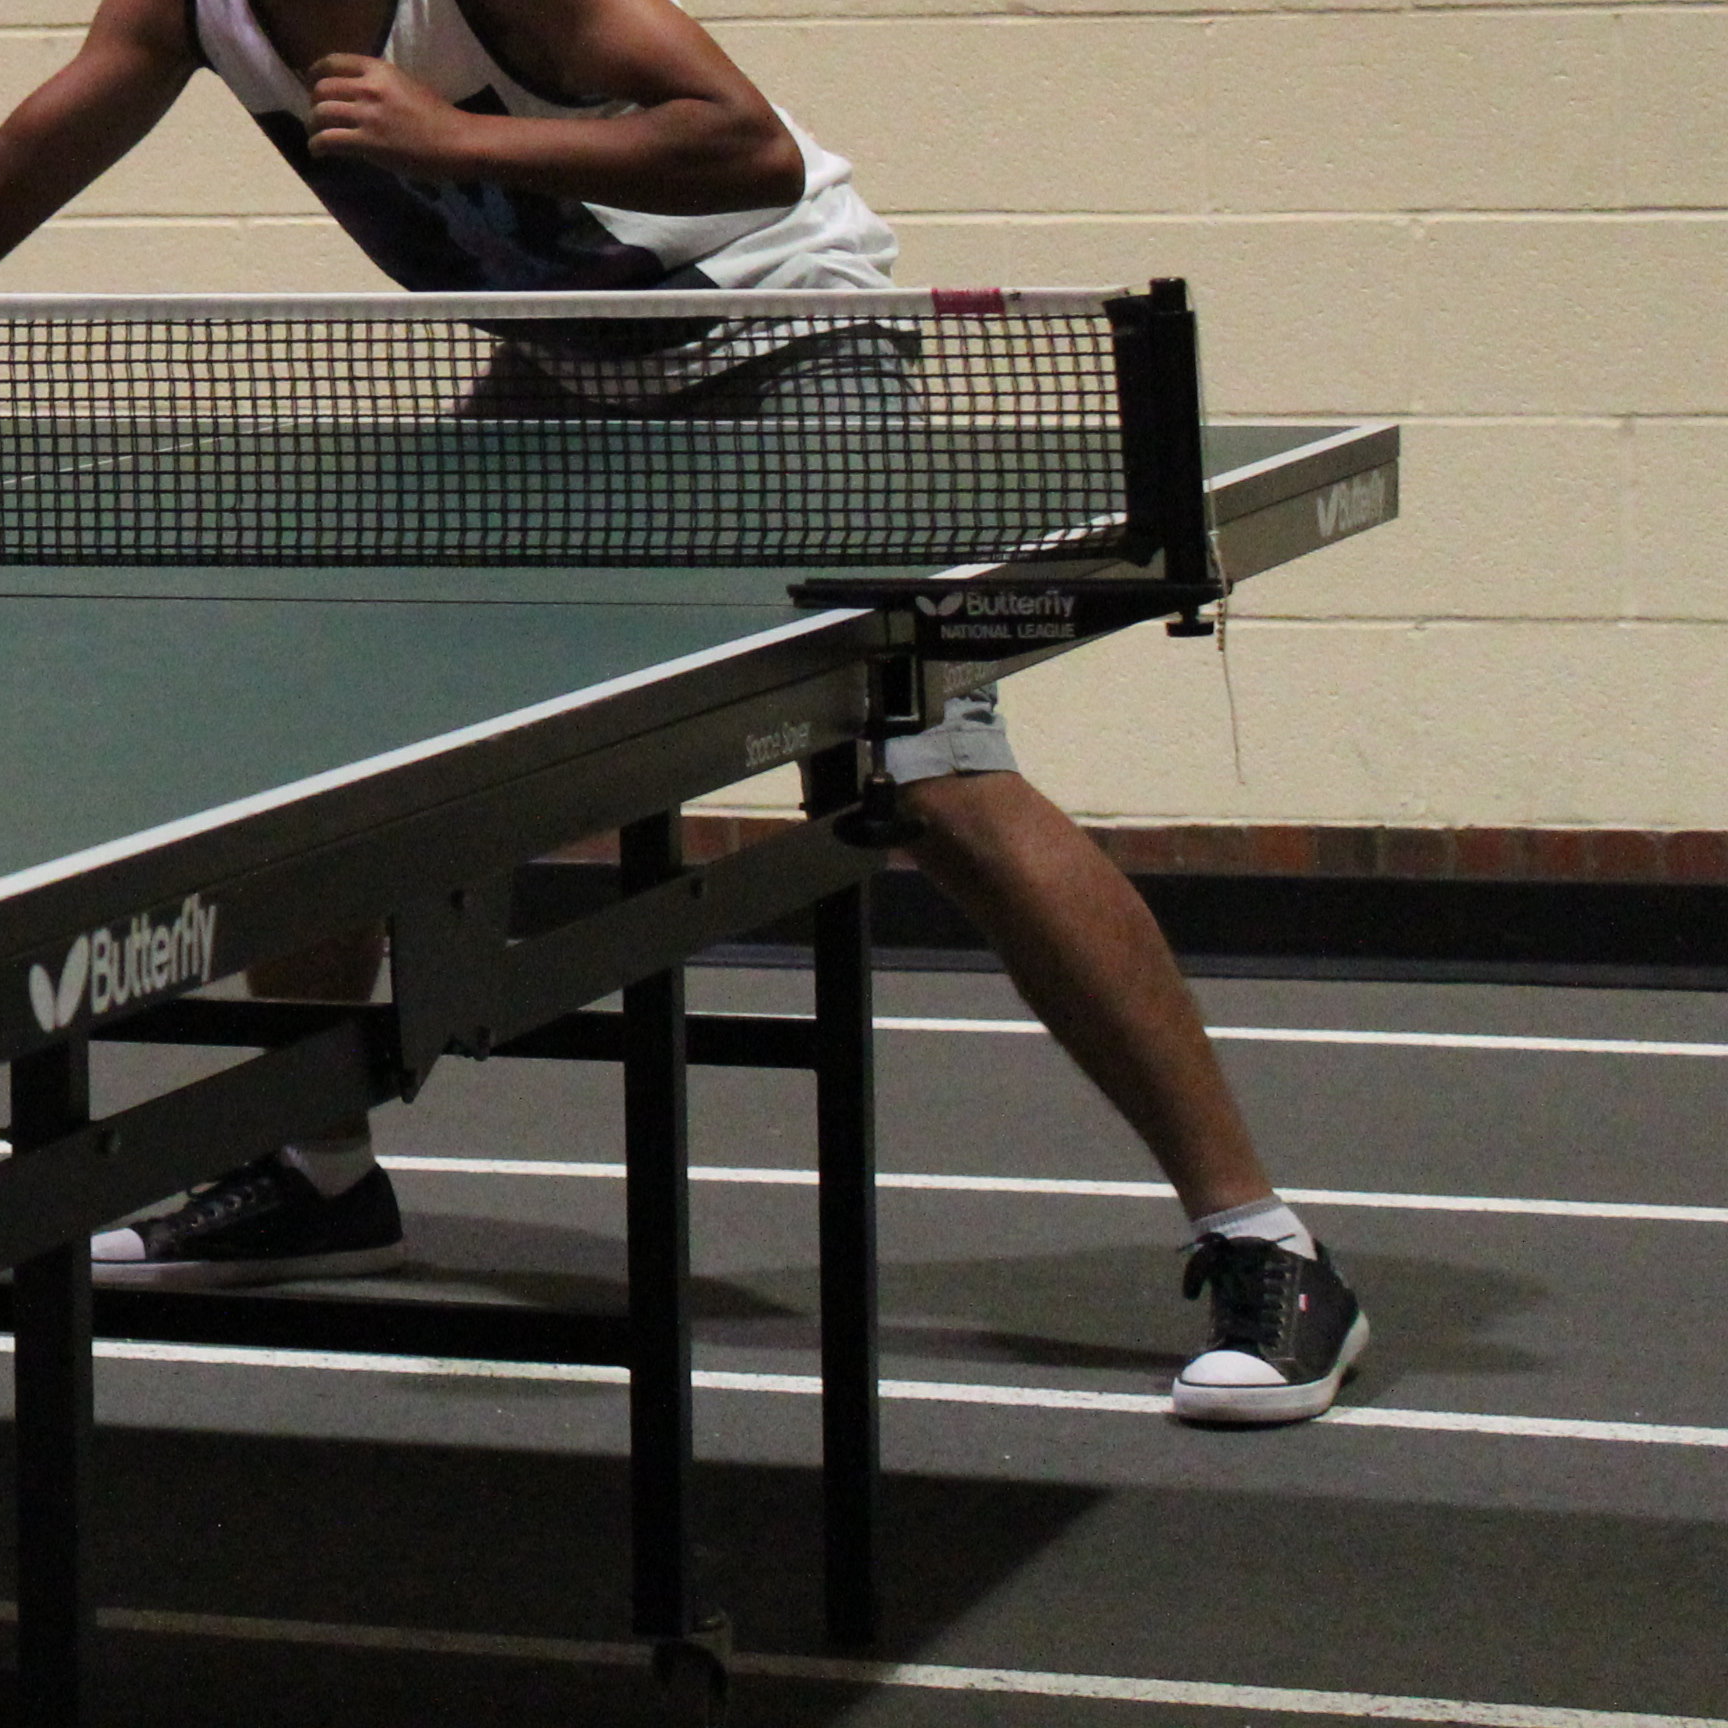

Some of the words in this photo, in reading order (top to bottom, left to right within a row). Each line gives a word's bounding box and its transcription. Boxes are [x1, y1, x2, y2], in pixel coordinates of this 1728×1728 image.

[966, 589, 1076, 618] Butterfly
[940, 624, 1013, 639] NATIONAL
[1017, 623, 1077, 639] LEAGUE
[90, 892, 218, 1015] Butterfly
